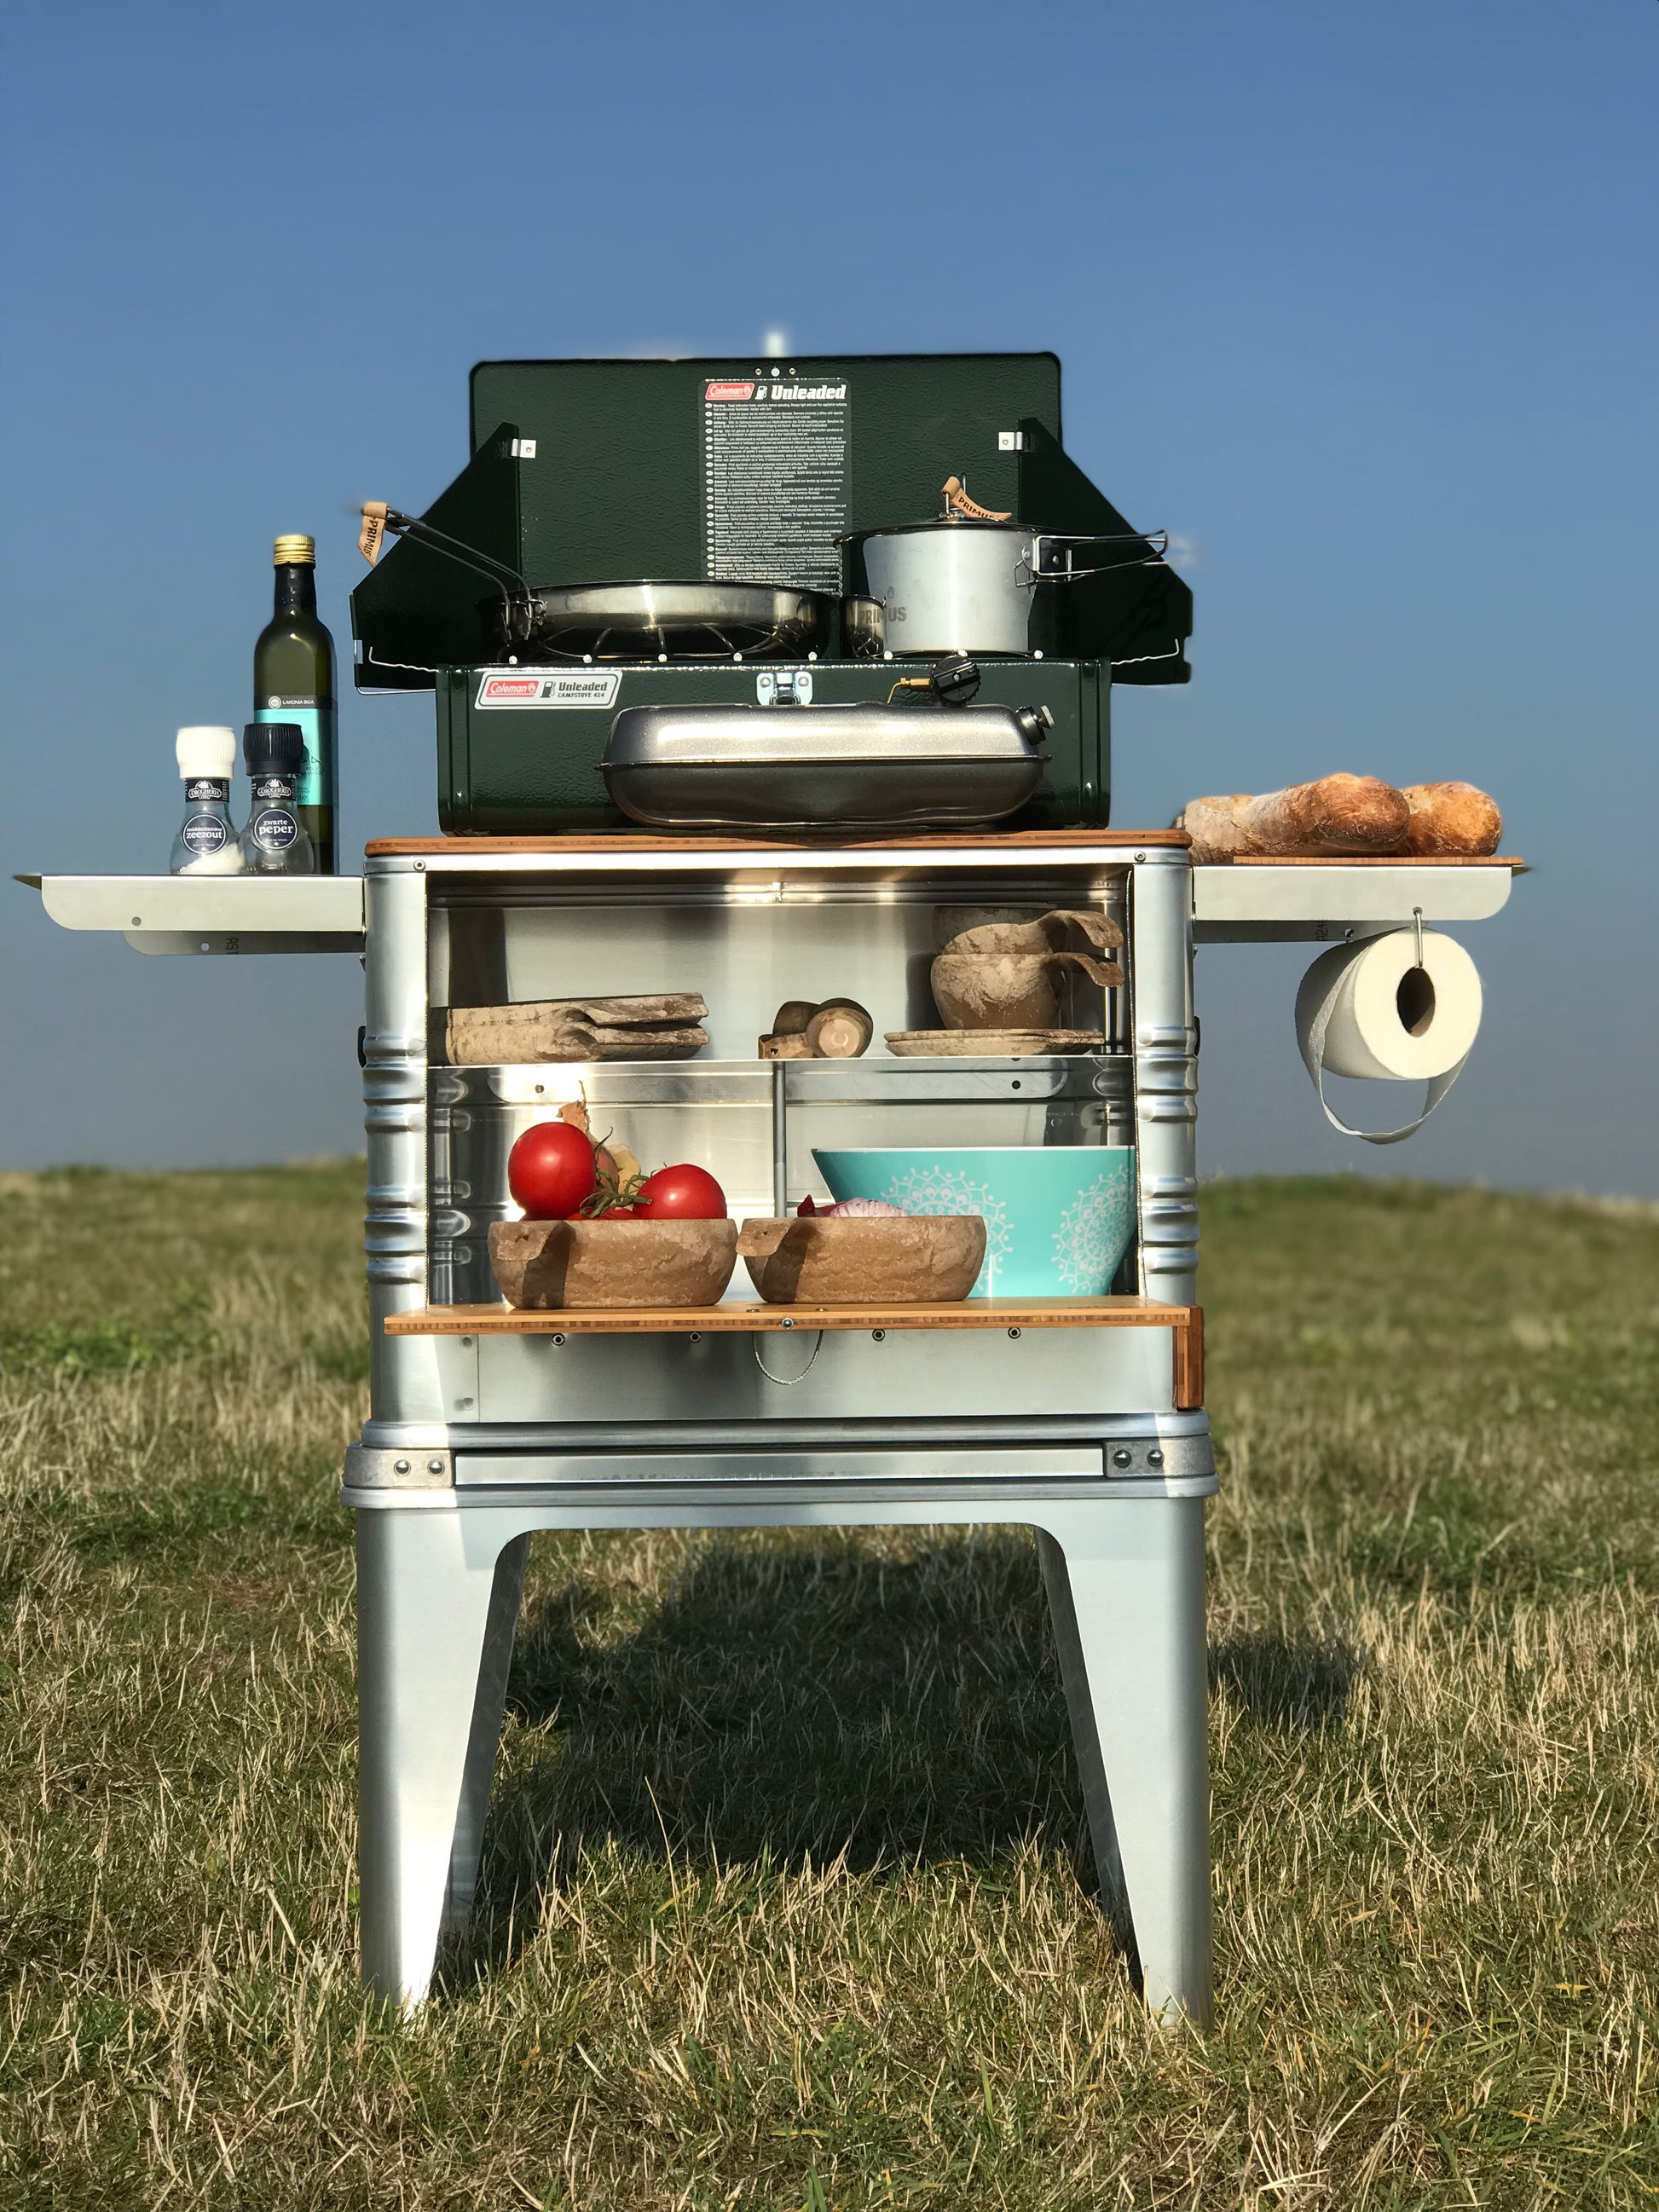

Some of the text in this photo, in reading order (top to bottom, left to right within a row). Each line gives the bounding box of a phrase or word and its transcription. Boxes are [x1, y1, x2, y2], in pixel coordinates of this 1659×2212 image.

[709, 384, 847, 400] Coleman Unleaded
[489, 682, 608, 694] Coleman Unleaded
[258, 826, 294, 835] peper
